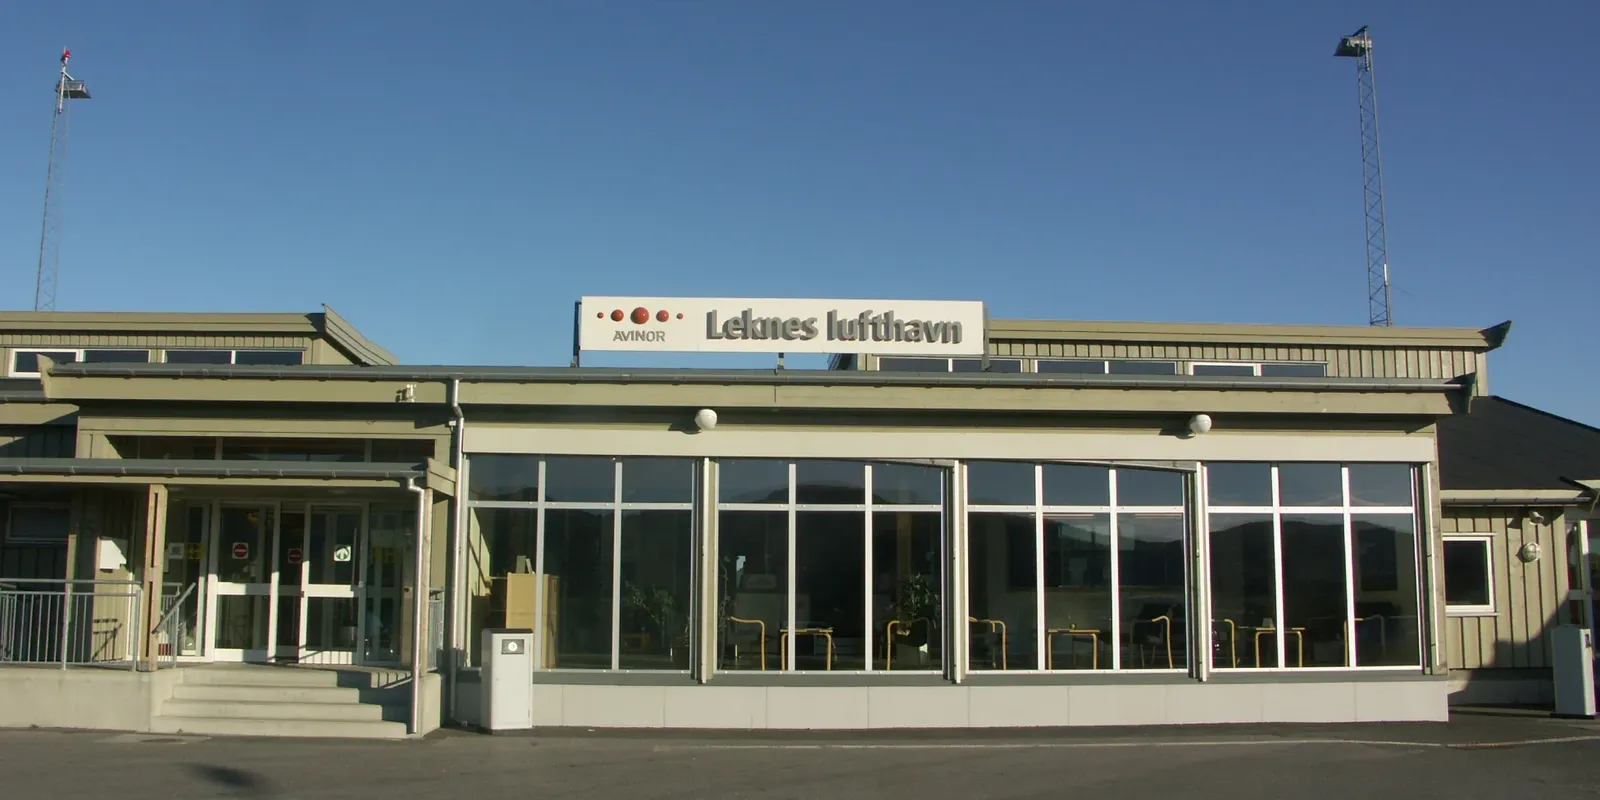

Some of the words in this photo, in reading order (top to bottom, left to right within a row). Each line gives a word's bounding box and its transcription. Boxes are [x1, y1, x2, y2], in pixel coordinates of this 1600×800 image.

[613, 330, 666, 342] AVINOR
[706, 309, 819, 340] Leknes
[826, 308, 963, 344] lufthavn
